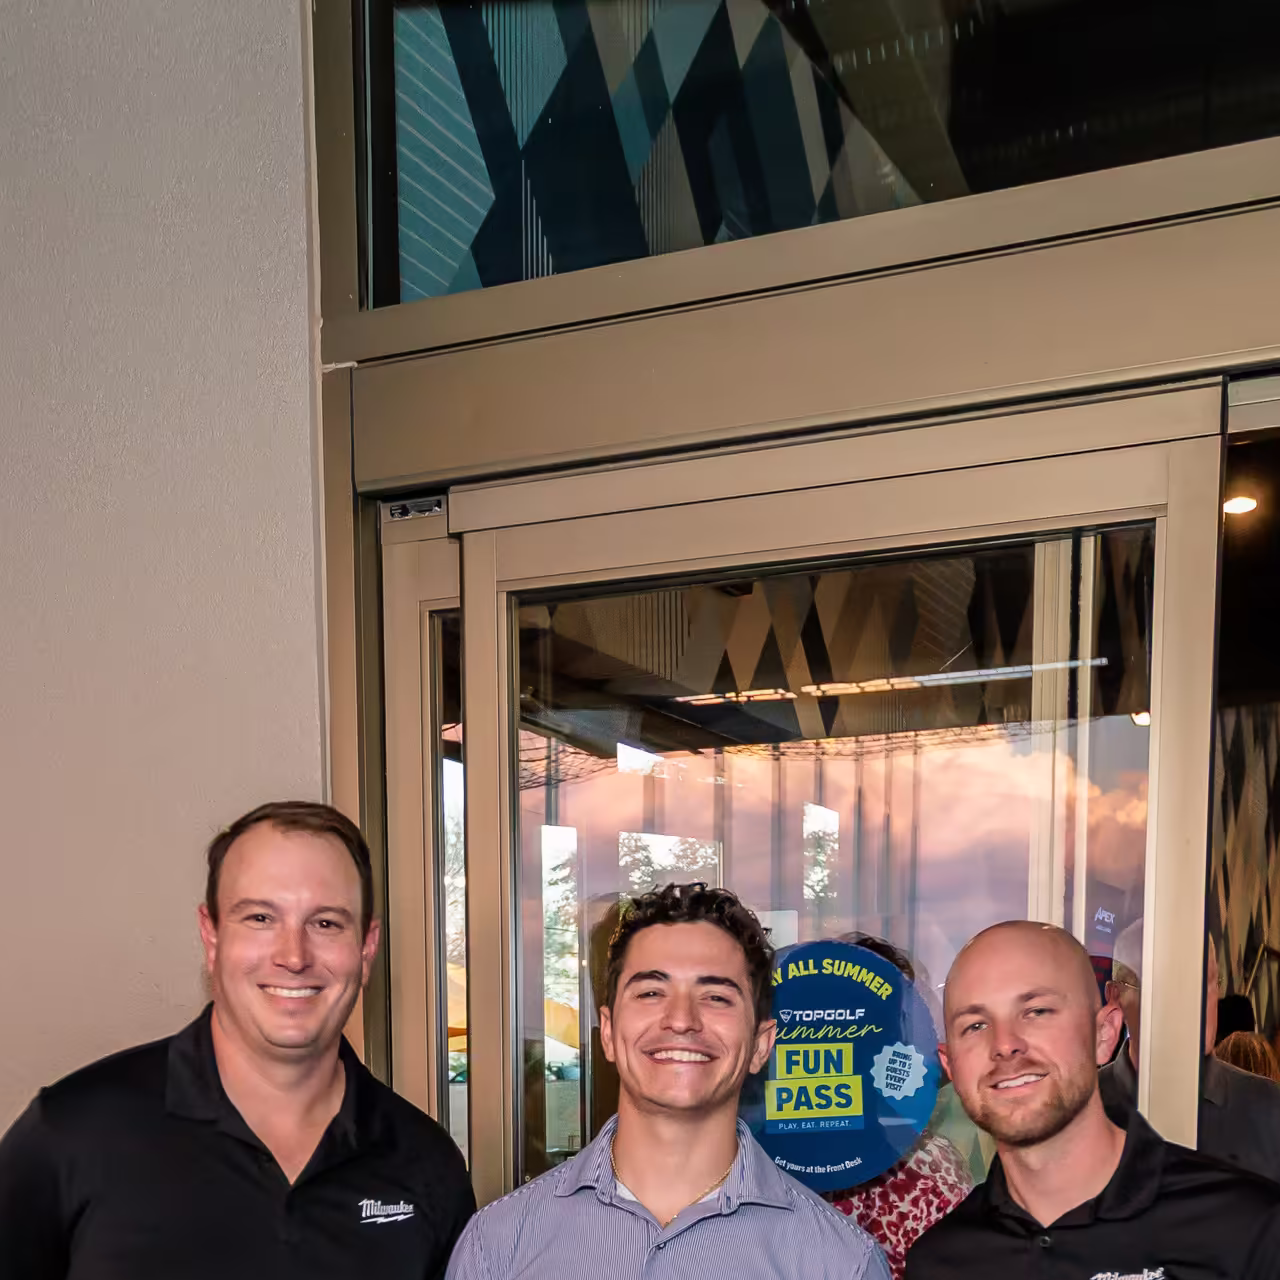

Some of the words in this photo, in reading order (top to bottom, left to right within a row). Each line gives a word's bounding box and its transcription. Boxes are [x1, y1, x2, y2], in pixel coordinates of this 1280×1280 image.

[788, 959, 819, 980] ALL
[822, 958, 893, 1001] SUMMER
[793, 1008, 865, 1021] TOPGOLF
[775, 1024, 883, 1039] ummer
[785, 1048, 843, 1075] FUN
[892, 1050, 912, 1061] BRING
[888, 1057, 898, 1066] UP
[898, 1060, 907, 1069] TO
[885, 1065, 911, 1078] GUESTS
[885, 1073, 907, 1085] EVERY
[885, 1081, 903, 1092] VISIT
[775, 1083, 853, 1112] PASS
[774, 1156, 787, 1167] Get
[786, 1162, 806, 1173] yours
[806, 1166, 814, 1174] at
[814, 1165, 826, 1173] the
[826, 1163, 846, 1173] Front
[844, 1157, 863, 1169] Desk
[358, 1198, 414, 1217] Milwaukee
